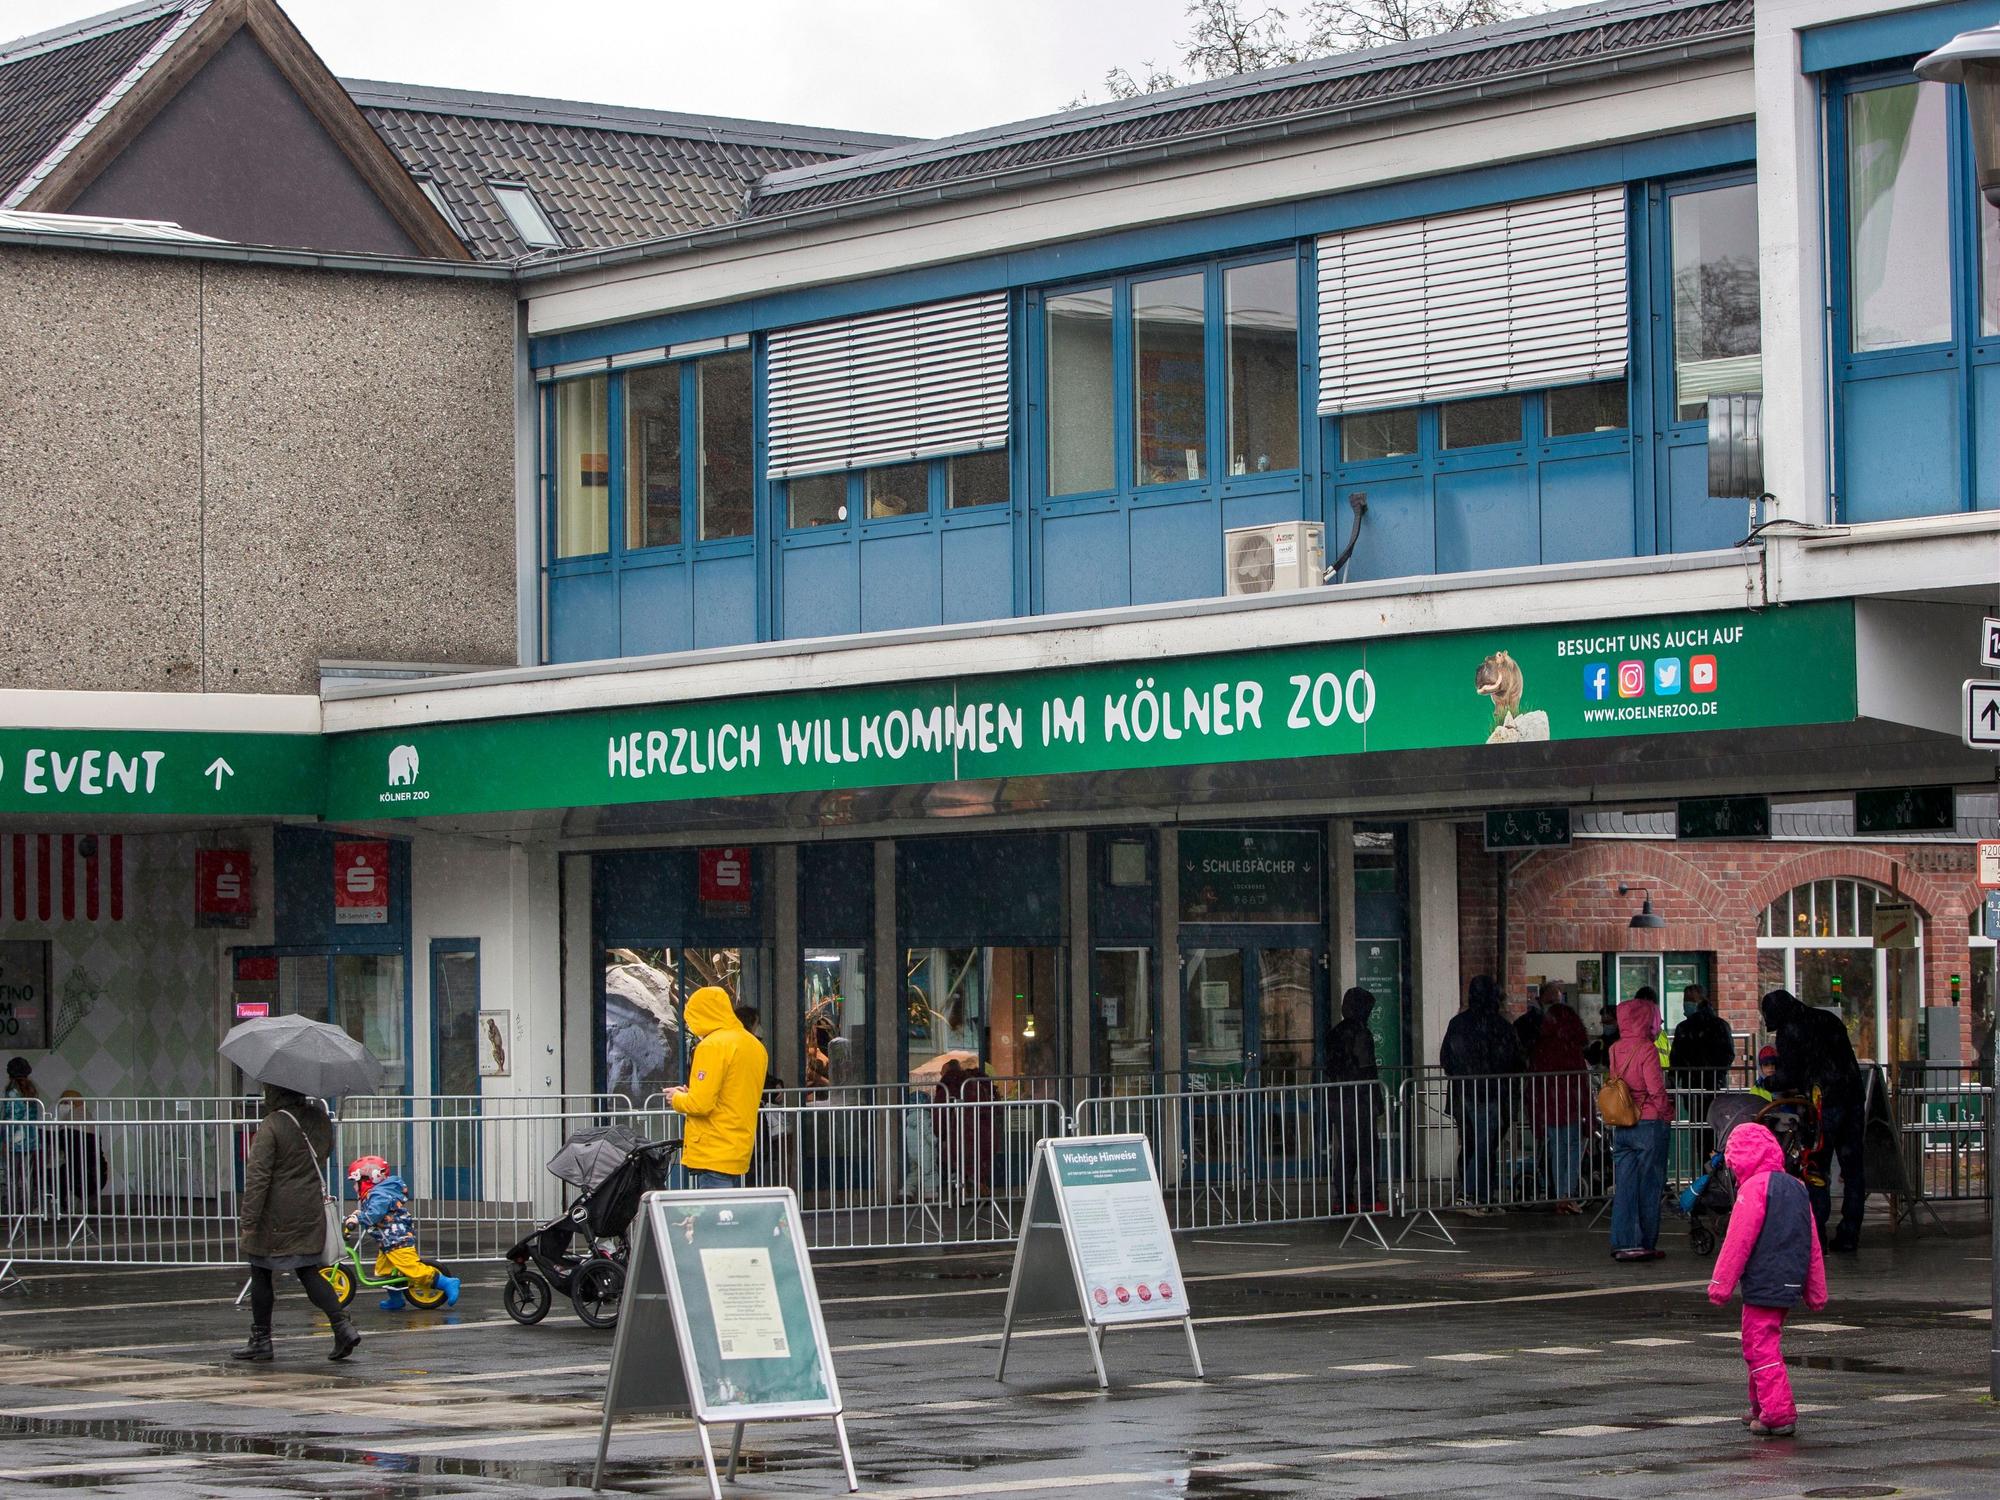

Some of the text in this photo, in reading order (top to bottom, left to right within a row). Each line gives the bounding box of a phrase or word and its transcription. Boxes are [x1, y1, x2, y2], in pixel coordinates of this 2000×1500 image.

[1558, 626, 1743, 656] BESUCHT UNS AUCH AUF
[608, 669, 1376, 778] HERZLICH WILLKOMMEN IM KÖLNER ZOO
[1584, 702, 1717, 722] WWW.KOELNERZOO.DE
[24, 748, 165, 796] EVENT
[379, 790, 430, 802] KÖLNER ZOO
[1063, 1150, 1137, 1165] Wichtige Hinweise
